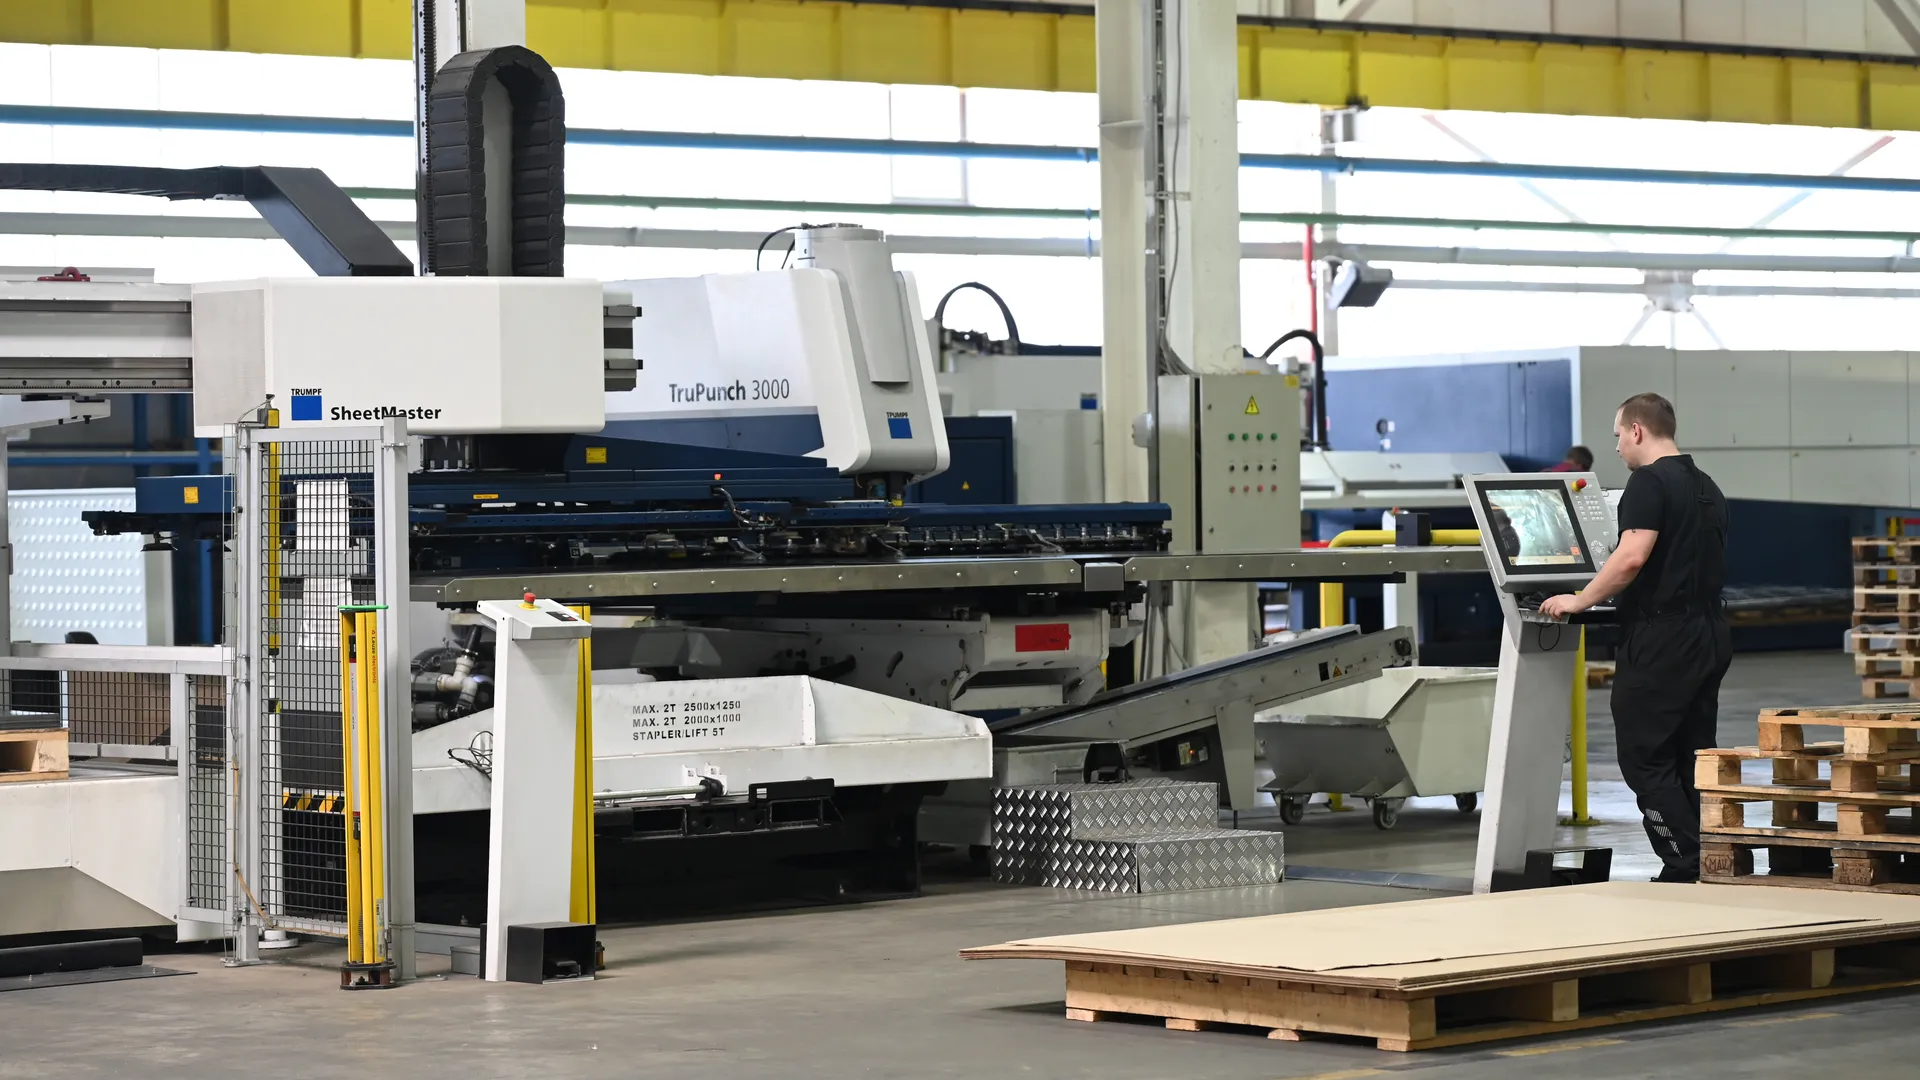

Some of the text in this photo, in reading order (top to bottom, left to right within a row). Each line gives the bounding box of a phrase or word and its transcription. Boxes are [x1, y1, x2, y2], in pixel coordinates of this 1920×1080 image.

[291, 388, 322, 396] TRUMPF
[668, 378, 790, 402] TruPunch 3000
[330, 406, 442, 420] SheetMaster
[632, 700, 741, 714] MAX. 2T 2500x1250
[632, 713, 741, 727] MAX. 2T 2000x1000
[712, 727, 725, 737] 5T
